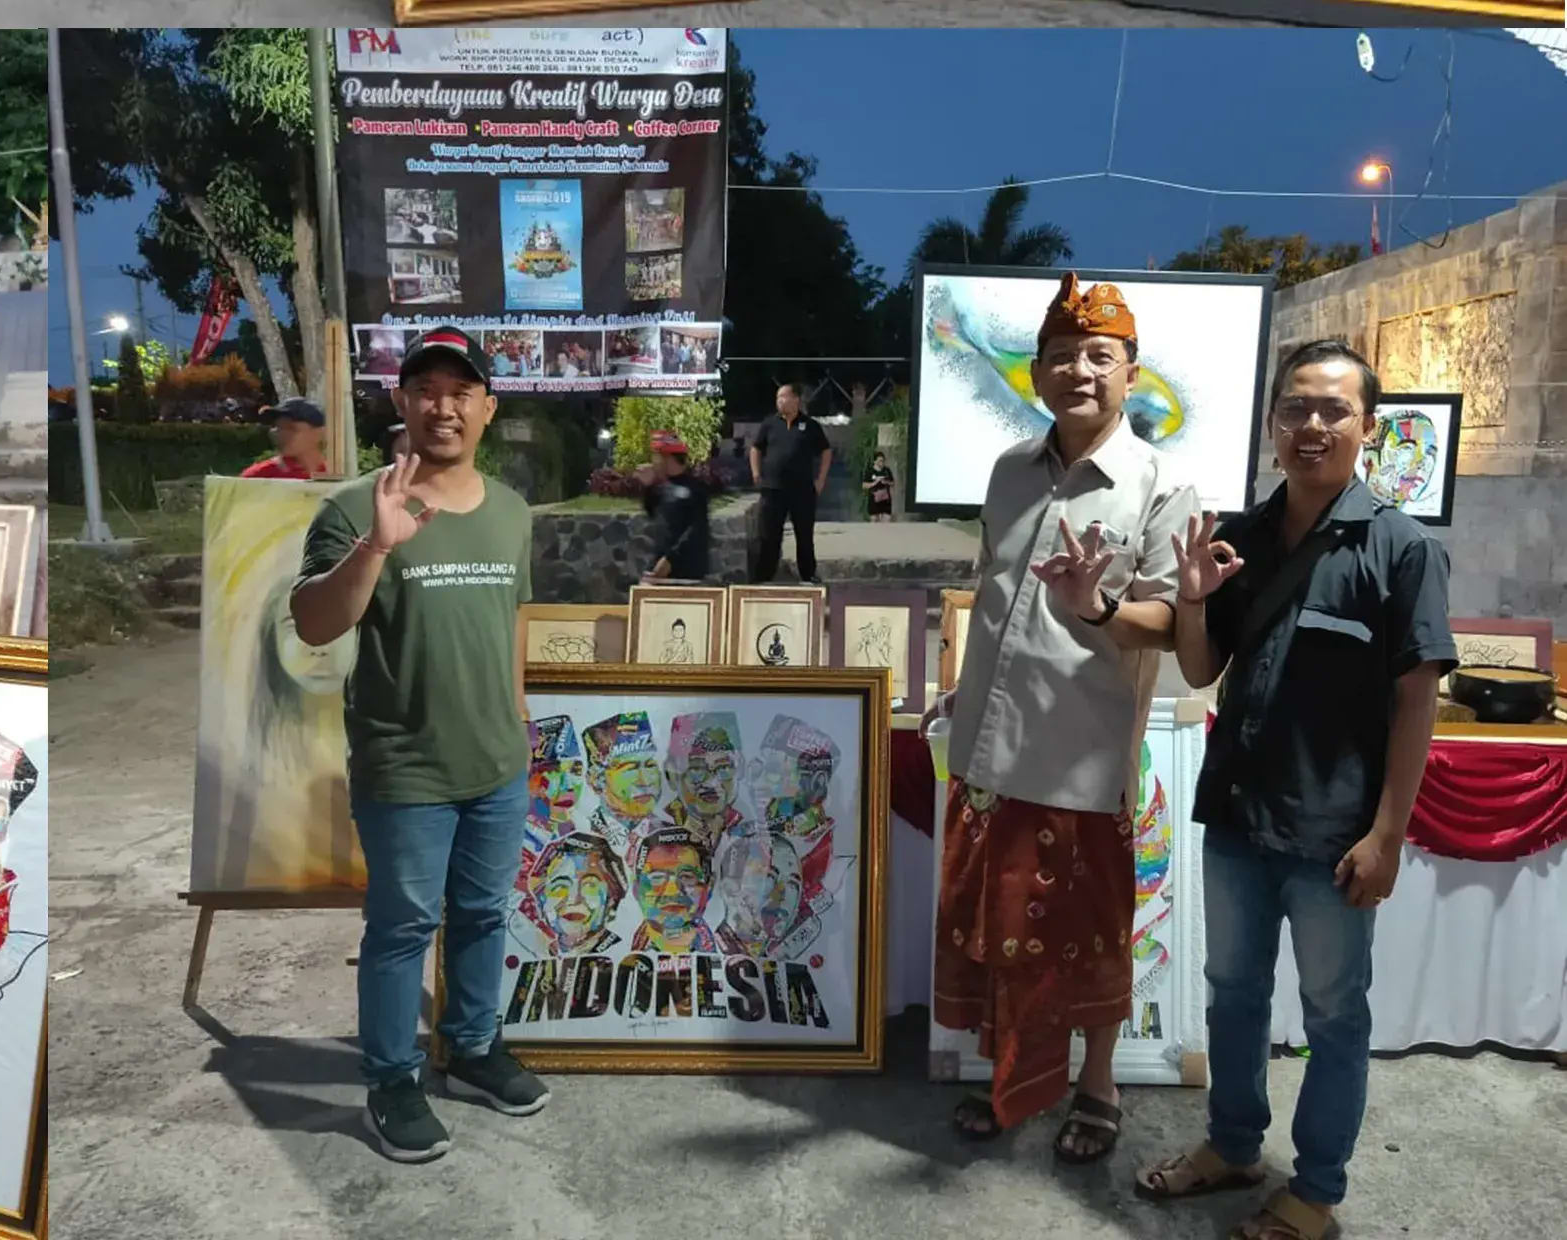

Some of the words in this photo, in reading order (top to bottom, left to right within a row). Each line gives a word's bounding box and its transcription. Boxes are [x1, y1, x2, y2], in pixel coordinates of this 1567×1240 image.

[341, 77, 506, 118] Pemberdayaan
[510, 79, 588, 119] Kreatif
[591, 79, 672, 119] Warga
[674, 80, 724, 108] Desa
[352, 118, 413, 135] Pameran
[414, 118, 468, 136] Lukisan
[481, 120, 540, 137] Pameran
[541, 119, 584, 140] Handy
[585, 119, 620, 137] Craft
[634, 120, 678, 137] Coffee
[679, 118, 721, 136] Corner
[402, 564, 431, 580] BANK
[431, 563, 471, 575] SAMPAH
[471, 563, 509, 575] GALANG
[503, 953, 831, 1028] INDONESIA
